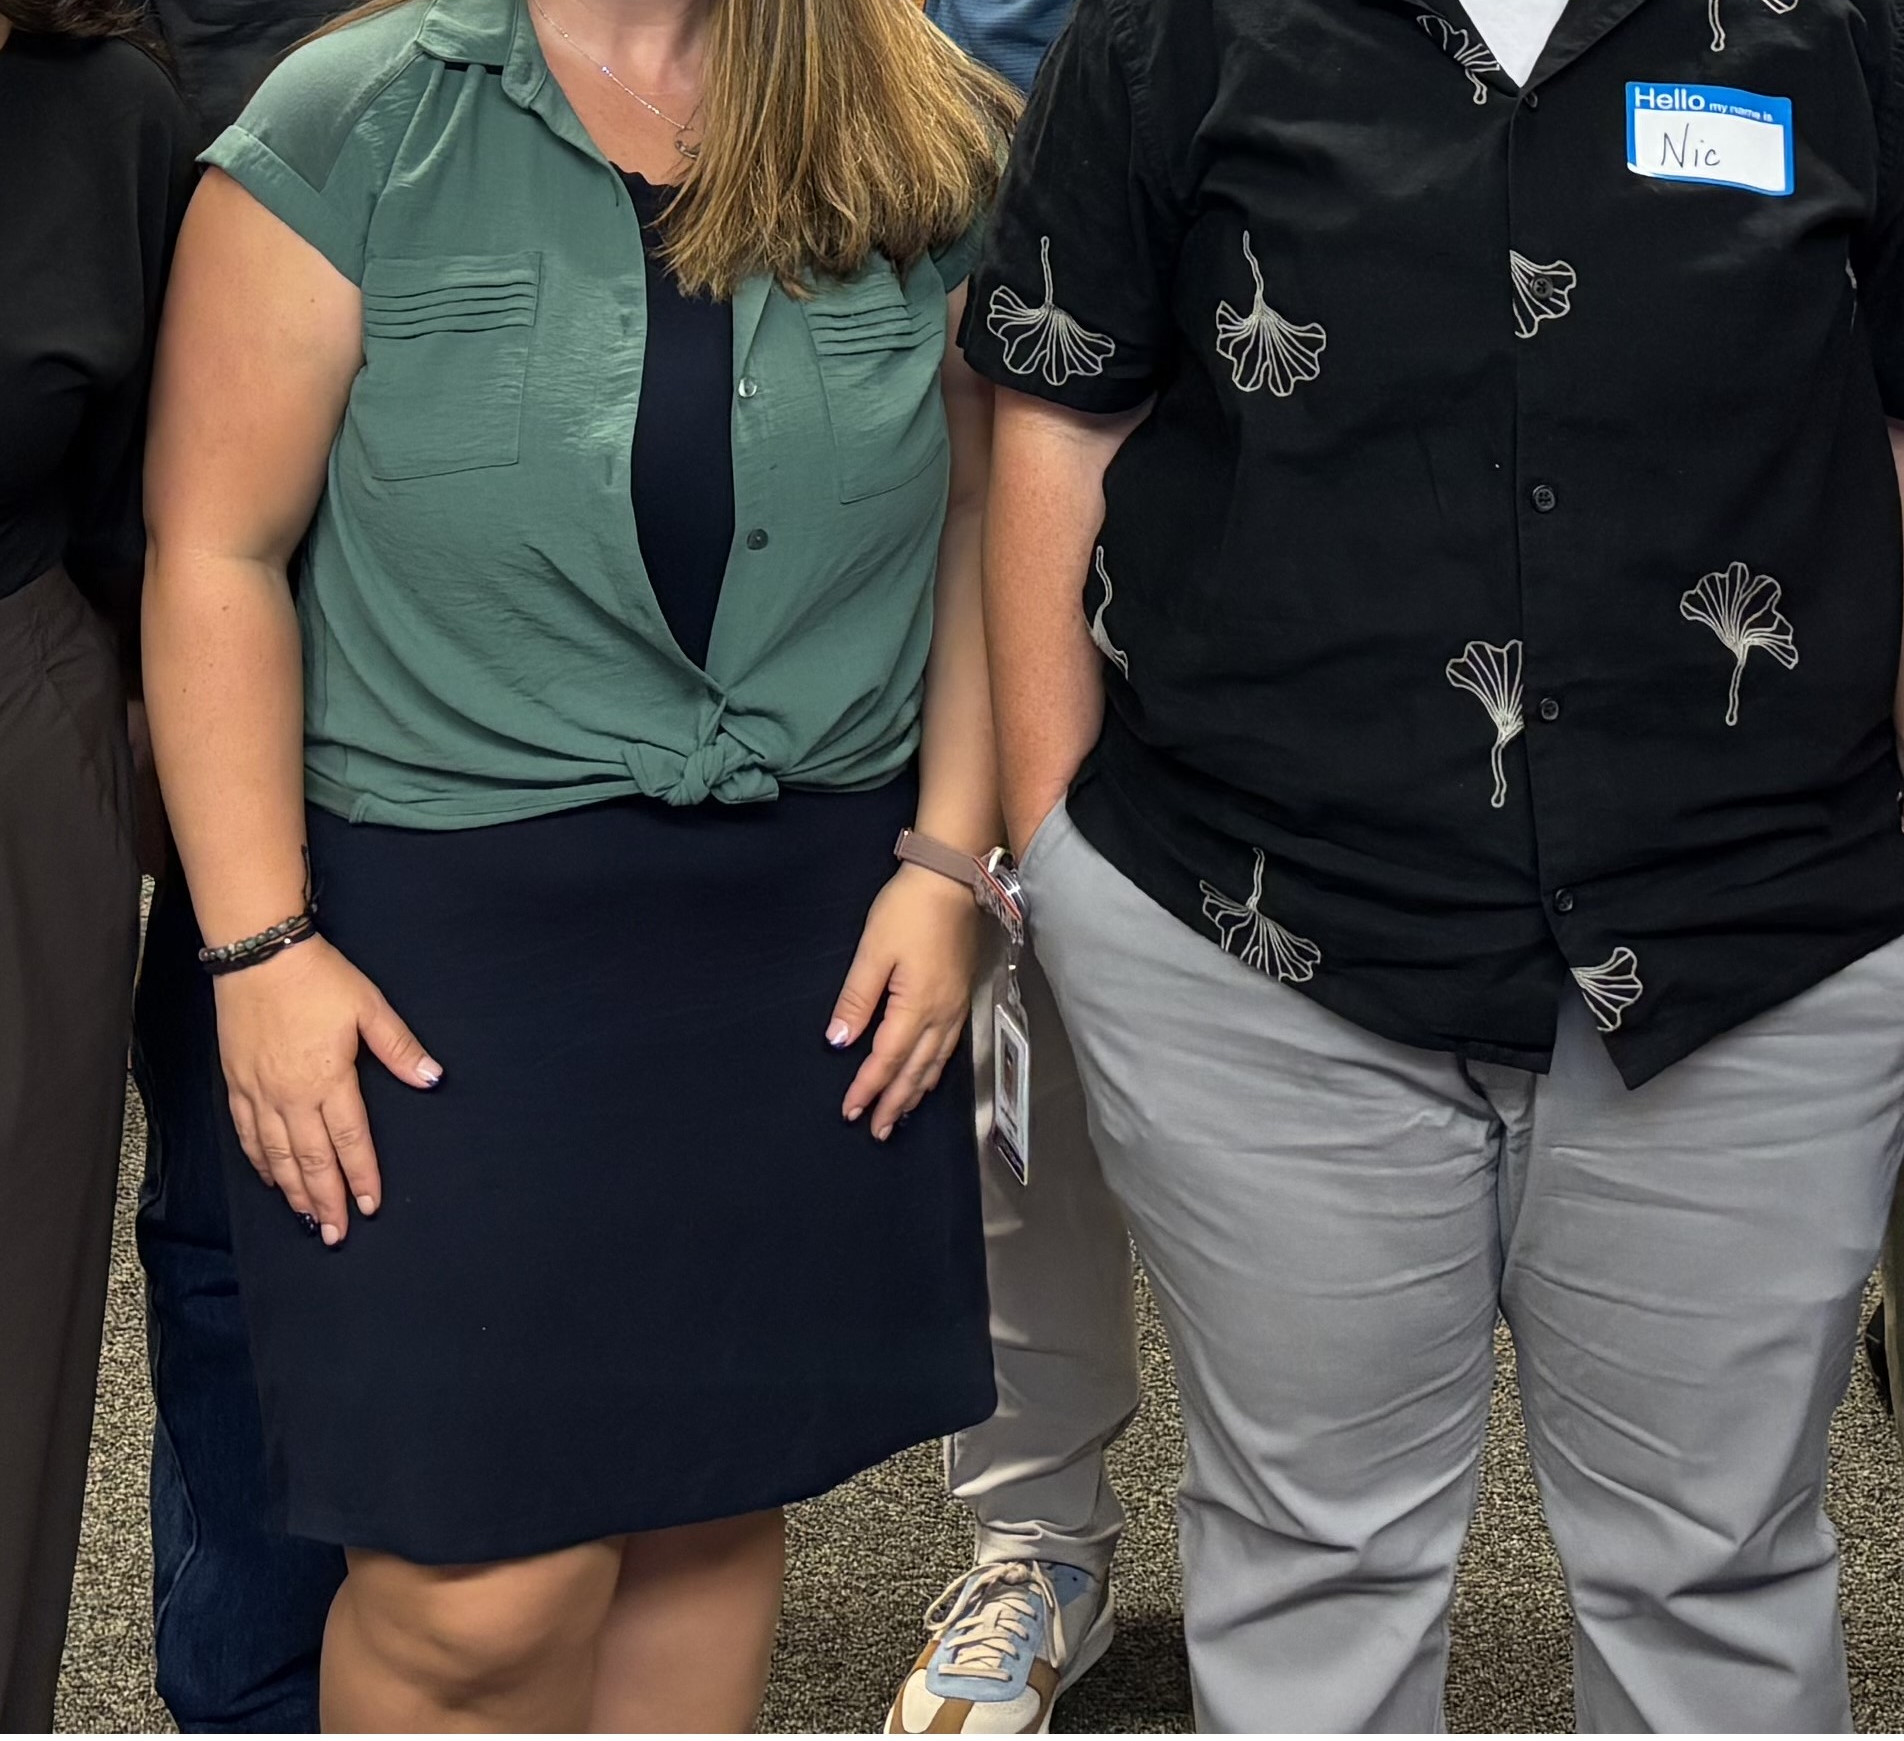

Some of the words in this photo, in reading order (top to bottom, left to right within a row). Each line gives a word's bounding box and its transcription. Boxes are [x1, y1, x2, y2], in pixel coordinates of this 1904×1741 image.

[1634, 86, 1705, 110] Hello
[1709, 102, 1728, 114] my
[1730, 106, 1761, 120] name
[1763, 111, 1774, 122] is
[1660, 122, 1721, 168] Nic
